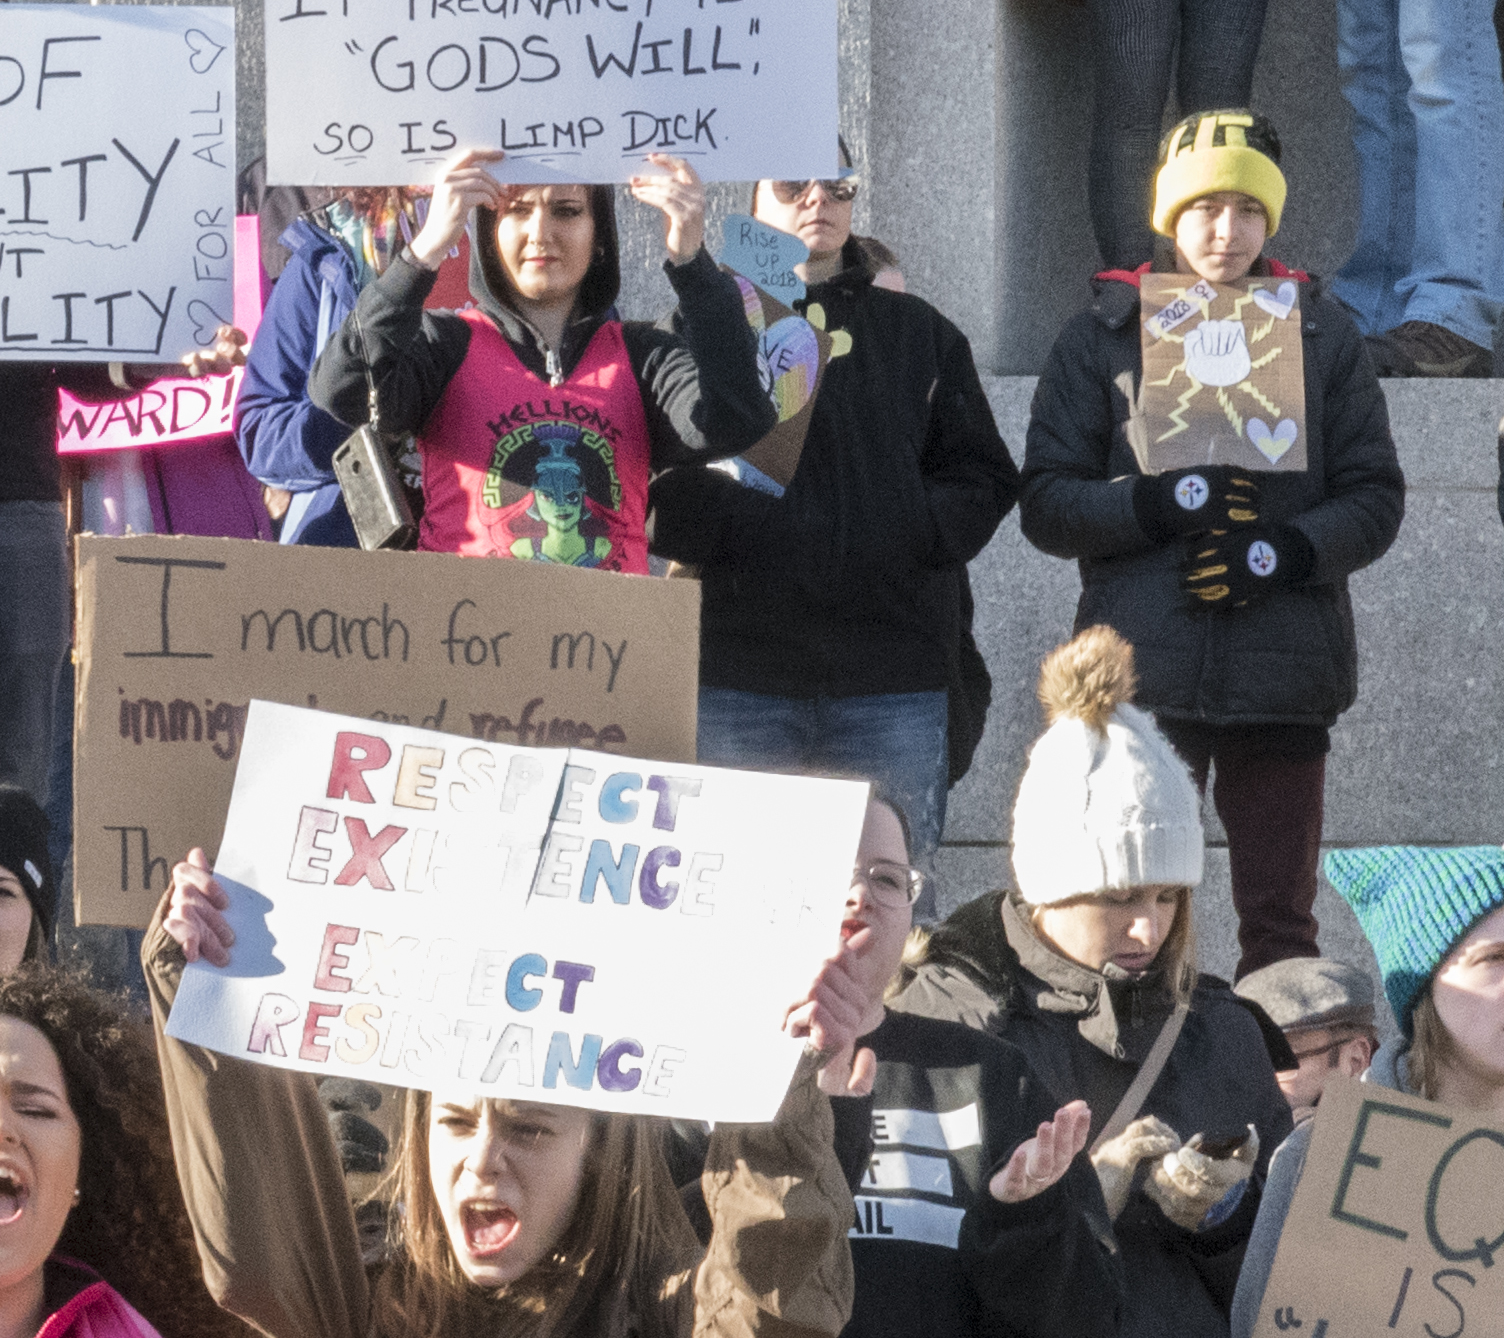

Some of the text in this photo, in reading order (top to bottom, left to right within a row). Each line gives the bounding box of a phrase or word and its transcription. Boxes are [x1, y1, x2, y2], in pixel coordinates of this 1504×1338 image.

[192, 90, 227, 282] FOR ALL
[313, 121, 374, 156] SO
[399, 120, 458, 154] IS
[500, 116, 605, 152] LIMP
[763, 335, 793, 372] VE
[485, 400, 623, 443] HELLIONS
[114, 555, 627, 693] I march for my
[325, 730, 702, 832] RESPECT
[286, 804, 724, 918] EXITENCE
[312, 922, 596, 1014] EXPECT
[246, 992, 687, 1099] RESISTANCE
